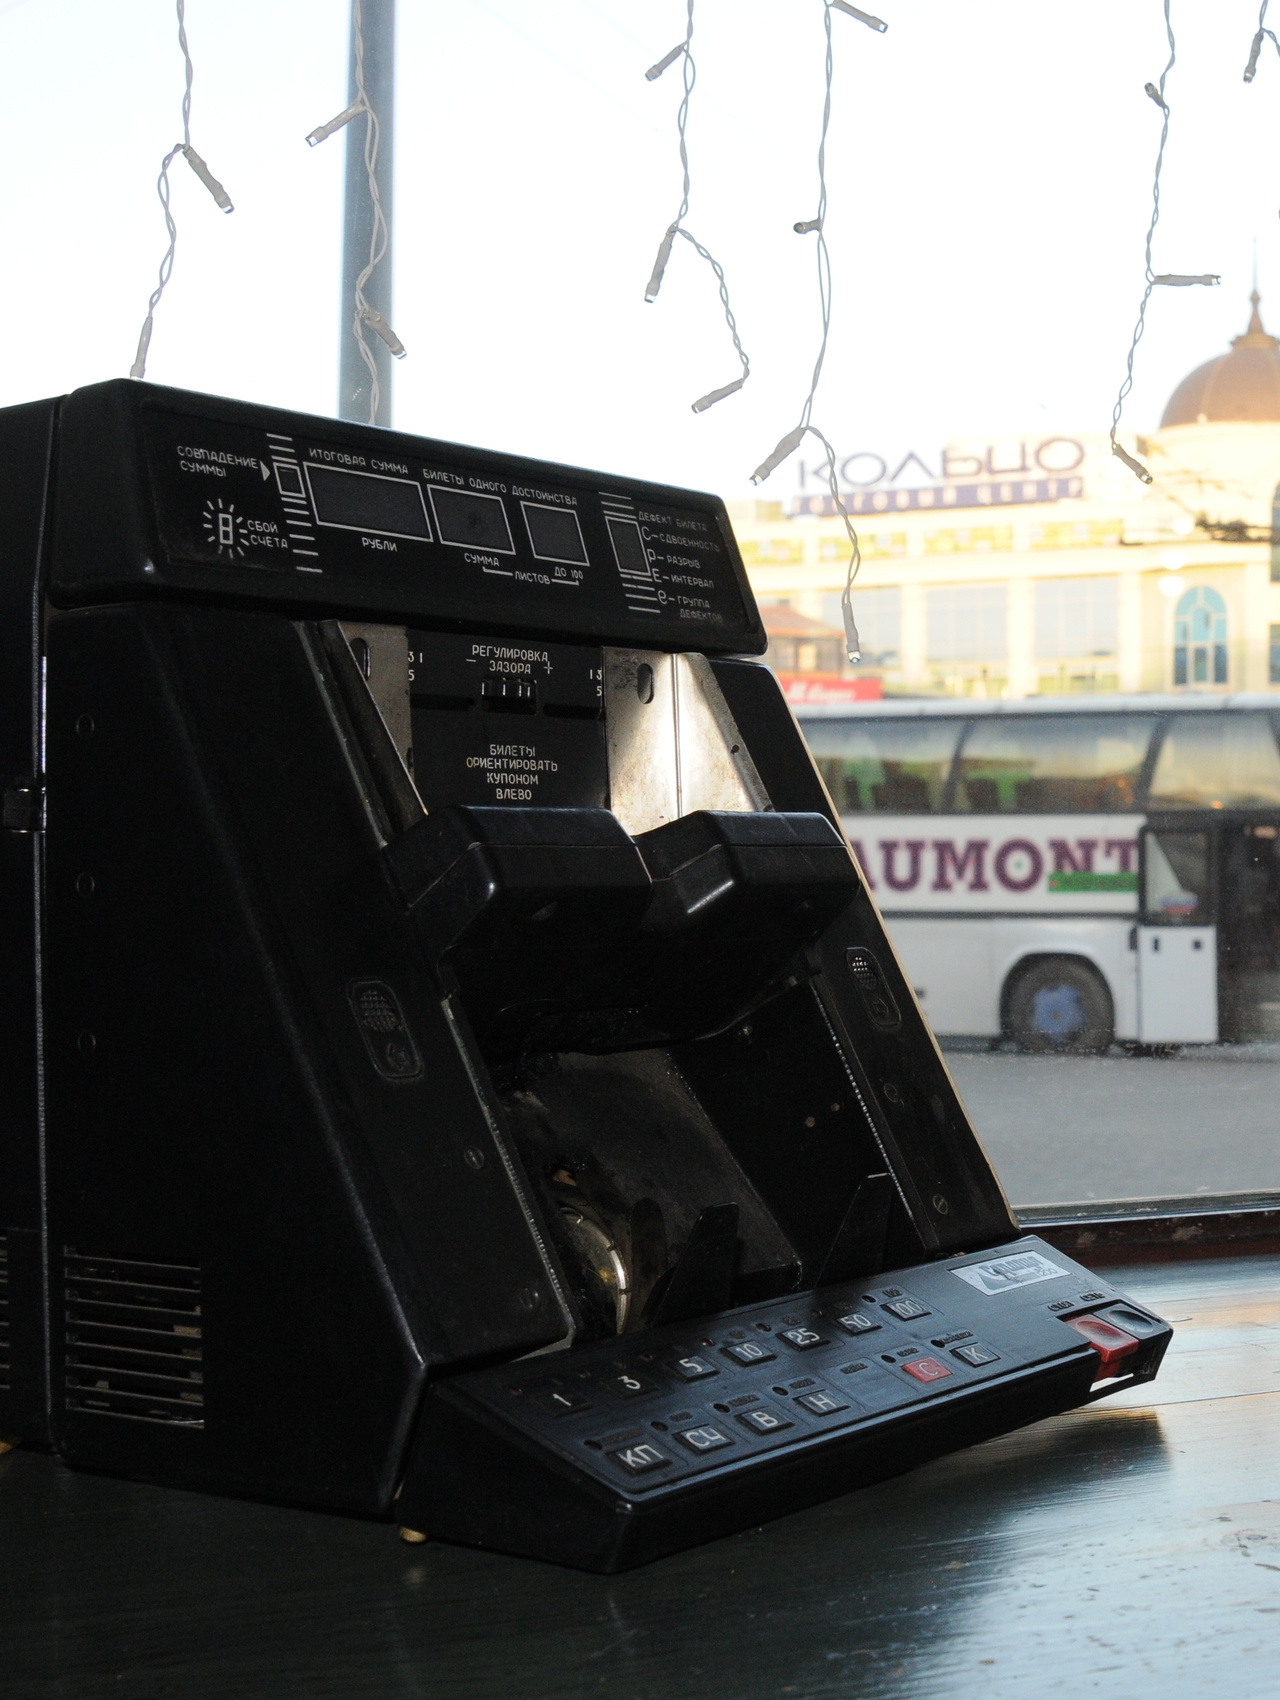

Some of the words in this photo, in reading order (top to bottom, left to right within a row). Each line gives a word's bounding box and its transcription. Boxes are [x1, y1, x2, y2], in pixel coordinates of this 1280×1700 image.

[177, 445, 258, 469] СОВПАДЕНИЕ
[309, 447, 366, 466] ИТОГОВАЯ
[370, 459, 409, 474] СУММА
[180, 460, 226, 477] СУММЫ
[423, 468, 464, 485] БИЛЕТЫ
[469, 477, 507, 493] ОДНОГО
[512, 485, 577, 506] ДОСТОИНСТВА
[247, 520, 278, 533] СБОЙ
[638, 511, 673, 526] ДЕФЕКТ
[676, 518, 708, 533] БИЛЕТА
[250, 535, 288, 549] СЧЕТА
[362, 537, 397, 552] РУБЛИ
[464, 552, 500, 567] СУММА
[666, 554, 701, 569] РАЗРЫВ
[515, 571, 550, 585] ЛИСТОВ
[554, 566, 567, 577] ДО
[571, 569, 584, 580] 100
[671, 574, 715, 589] ИНТЕРВАЛ
[677, 595, 710, 609] ГРУППА
[680, 608, 723, 623] ДЕФЕКТОВ
[472, 644, 549, 663] РЕГУЛИРОВКА
[408, 669, 415, 681] 5
[489, 660, 531, 675] ЗАЗОРА
[596, 685, 602, 697] 5
[489, 744, 536, 757] БИЛЕТЫ
[466, 757, 558, 772] ОРИЕНТИРОВАТЬ
[486, 772, 539, 785] КУПОНОМ
[496, 788, 532, 800] ВЛЕВО
[552, 1392, 572, 1407] 1
[617, 1375, 641, 1390] 3
[679, 1357, 703, 1373] 5
[735, 1343, 763, 1358] 10
[788, 1327, 820, 1345] 25
[841, 1313, 872, 1328] 50
[893, 1299, 925, 1316] 100
[619, 1443, 664, 1467] КП
[685, 1428, 726, 1448] СЧ
